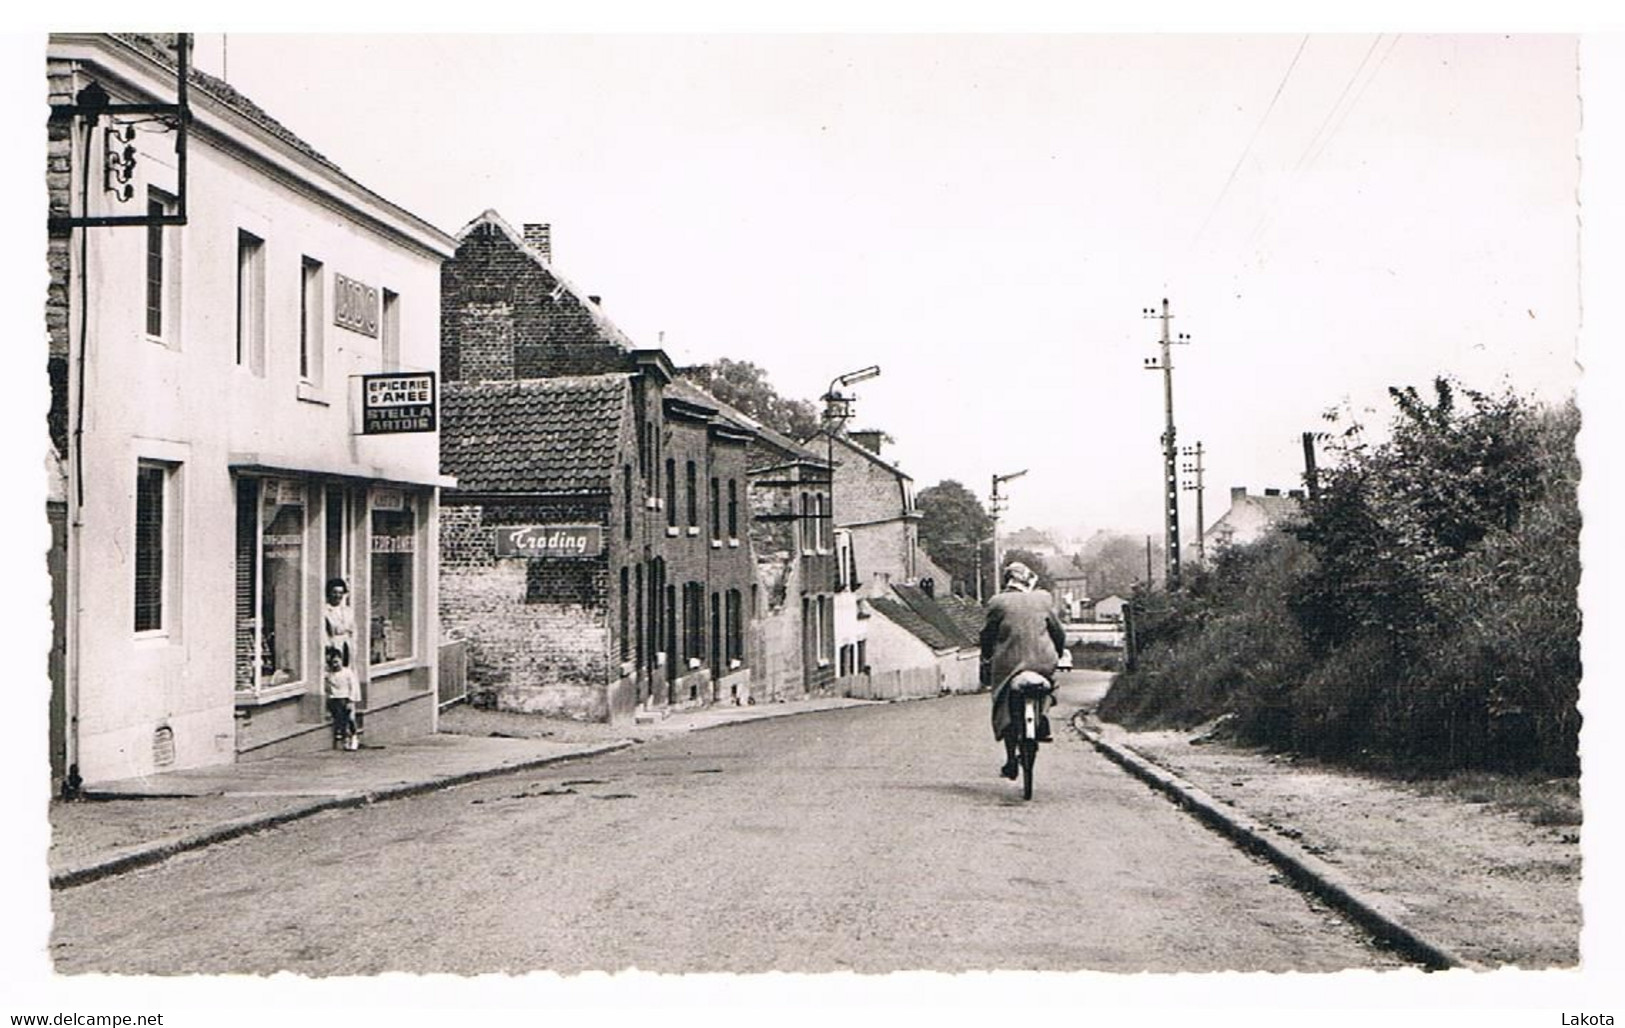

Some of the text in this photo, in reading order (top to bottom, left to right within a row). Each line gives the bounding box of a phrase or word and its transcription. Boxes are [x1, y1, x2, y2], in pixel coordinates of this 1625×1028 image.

[369, 380, 429, 392] EPICERIE
[367, 407, 432, 419] STELLA
[370, 418, 429, 430] ARTOIS
[509, 527, 587, 553] Trading
